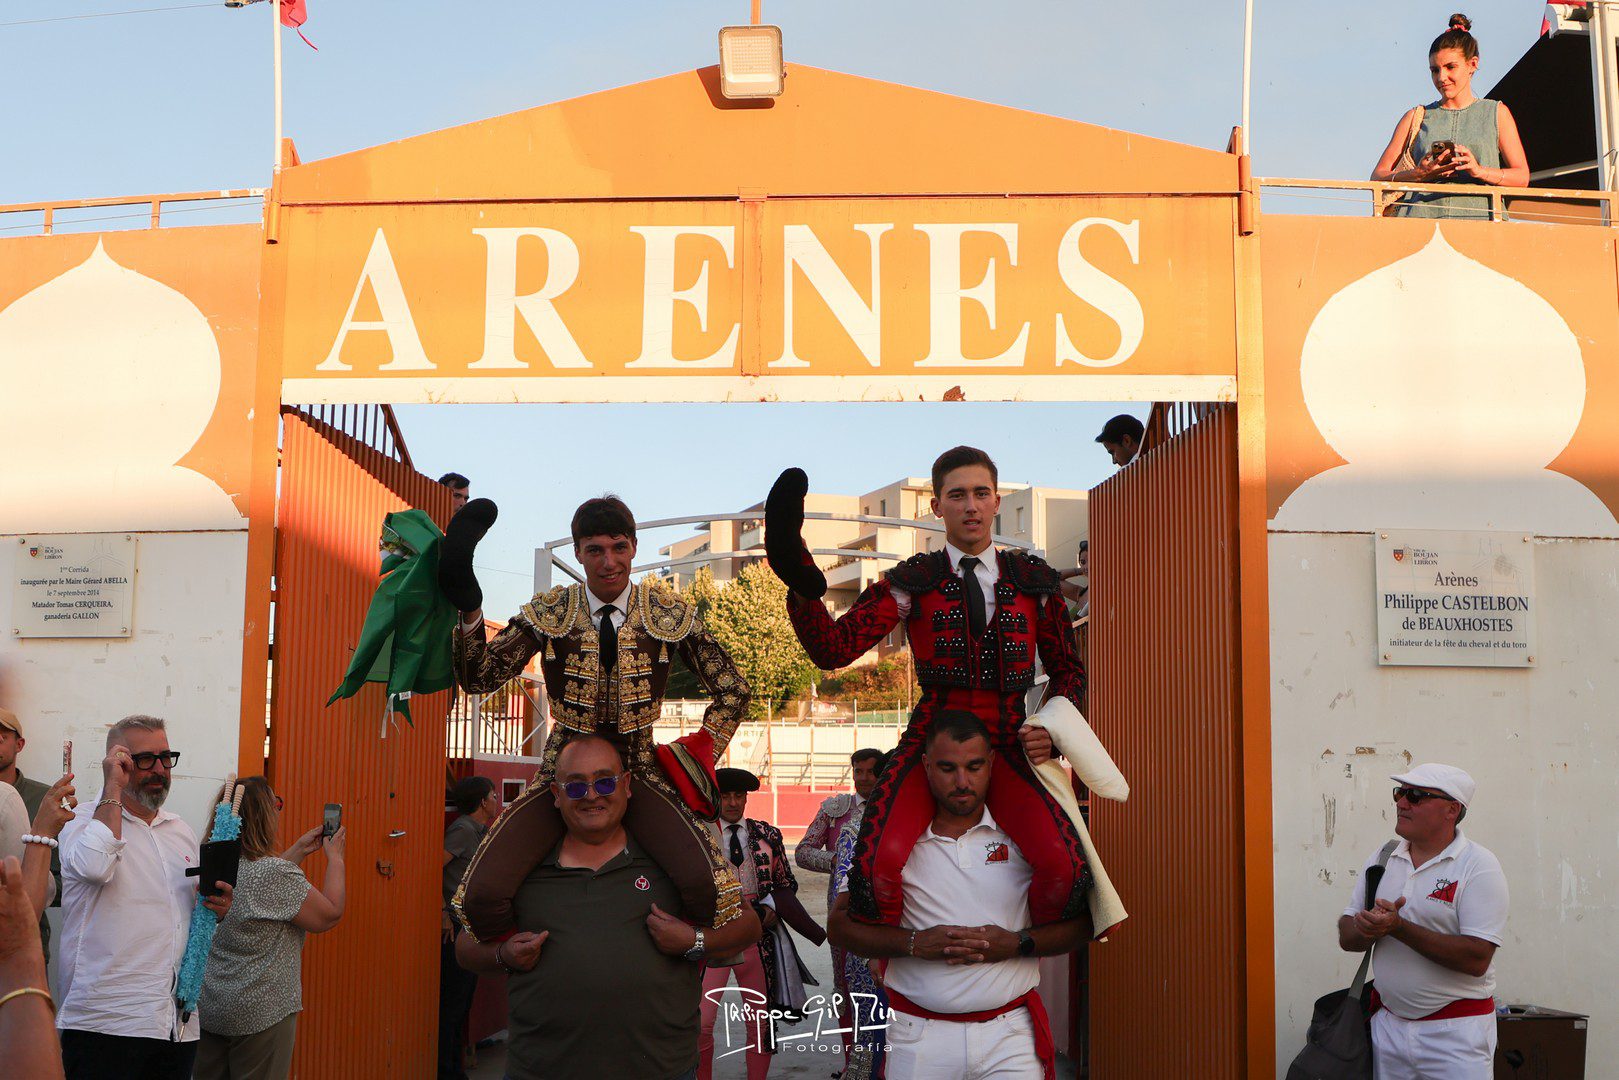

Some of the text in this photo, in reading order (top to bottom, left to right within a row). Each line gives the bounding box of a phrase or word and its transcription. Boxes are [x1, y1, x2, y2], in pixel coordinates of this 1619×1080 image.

[315, 217, 1146, 372] ARENES
[20, 579, 48, 587] inaugurée
[1434, 571, 1479, 587] Arènes
[57, 590, 86, 598] septembre
[1384, 594, 1529, 614] Philippe CASTELBON
[1402, 617, 1513, 632] de BEAUXHOSTES
[1389, 638, 1423, 647] initiateur
[1424, 638, 1433, 647] de
[1434, 639, 1441, 647] la
[1442, 638, 1457, 648] fête
[1458, 639, 1468, 648] du
[1469, 640, 1492, 649] cheval
[1501, 640, 1512, 649] du
[1512, 640, 1527, 649] toro
